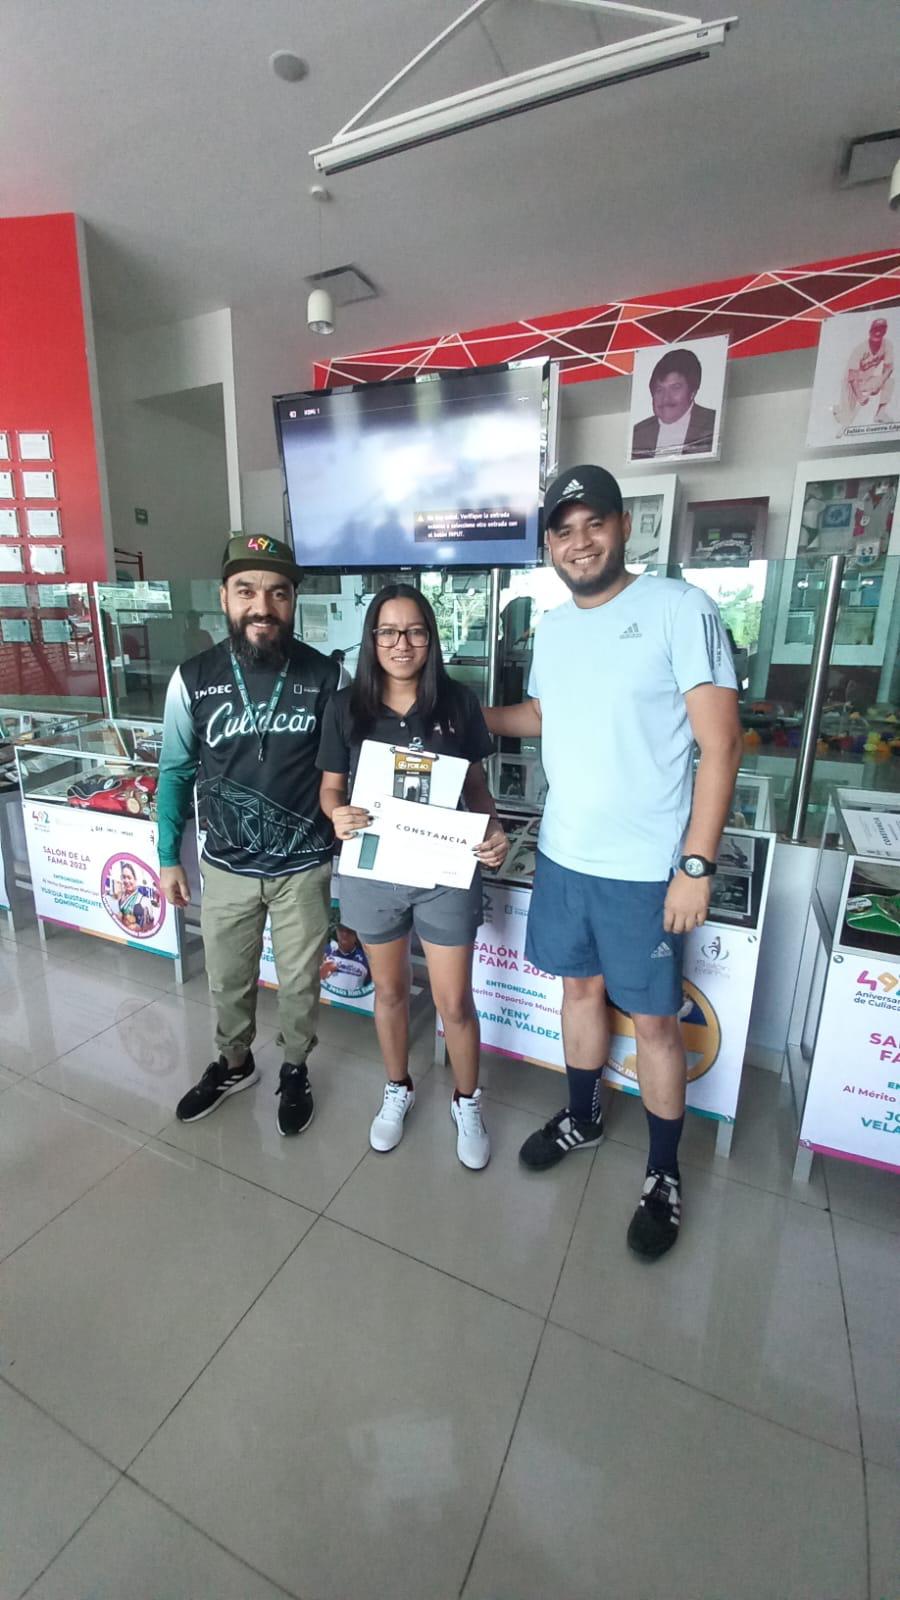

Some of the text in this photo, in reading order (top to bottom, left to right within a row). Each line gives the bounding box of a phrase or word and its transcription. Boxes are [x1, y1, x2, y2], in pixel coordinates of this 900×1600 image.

[396, 823, 468, 845] CONSTANCIA
[42, 845, 92, 864] SALÓN DE LA
[47, 855, 88, 871] FAMA 2023
[472, 941, 518, 959] SALÓN
[479, 955, 519, 971] FAMA
[486, 980, 547, 999] ENTRONIZADA:
[856, 969, 900, 995] 49
[495, 992, 533, 1007] Deportivo
[500, 1006, 530, 1020] YENY
[515, 1020, 560, 1040] VALDEZ
[842, 1084, 897, 1103] Al Mérito
